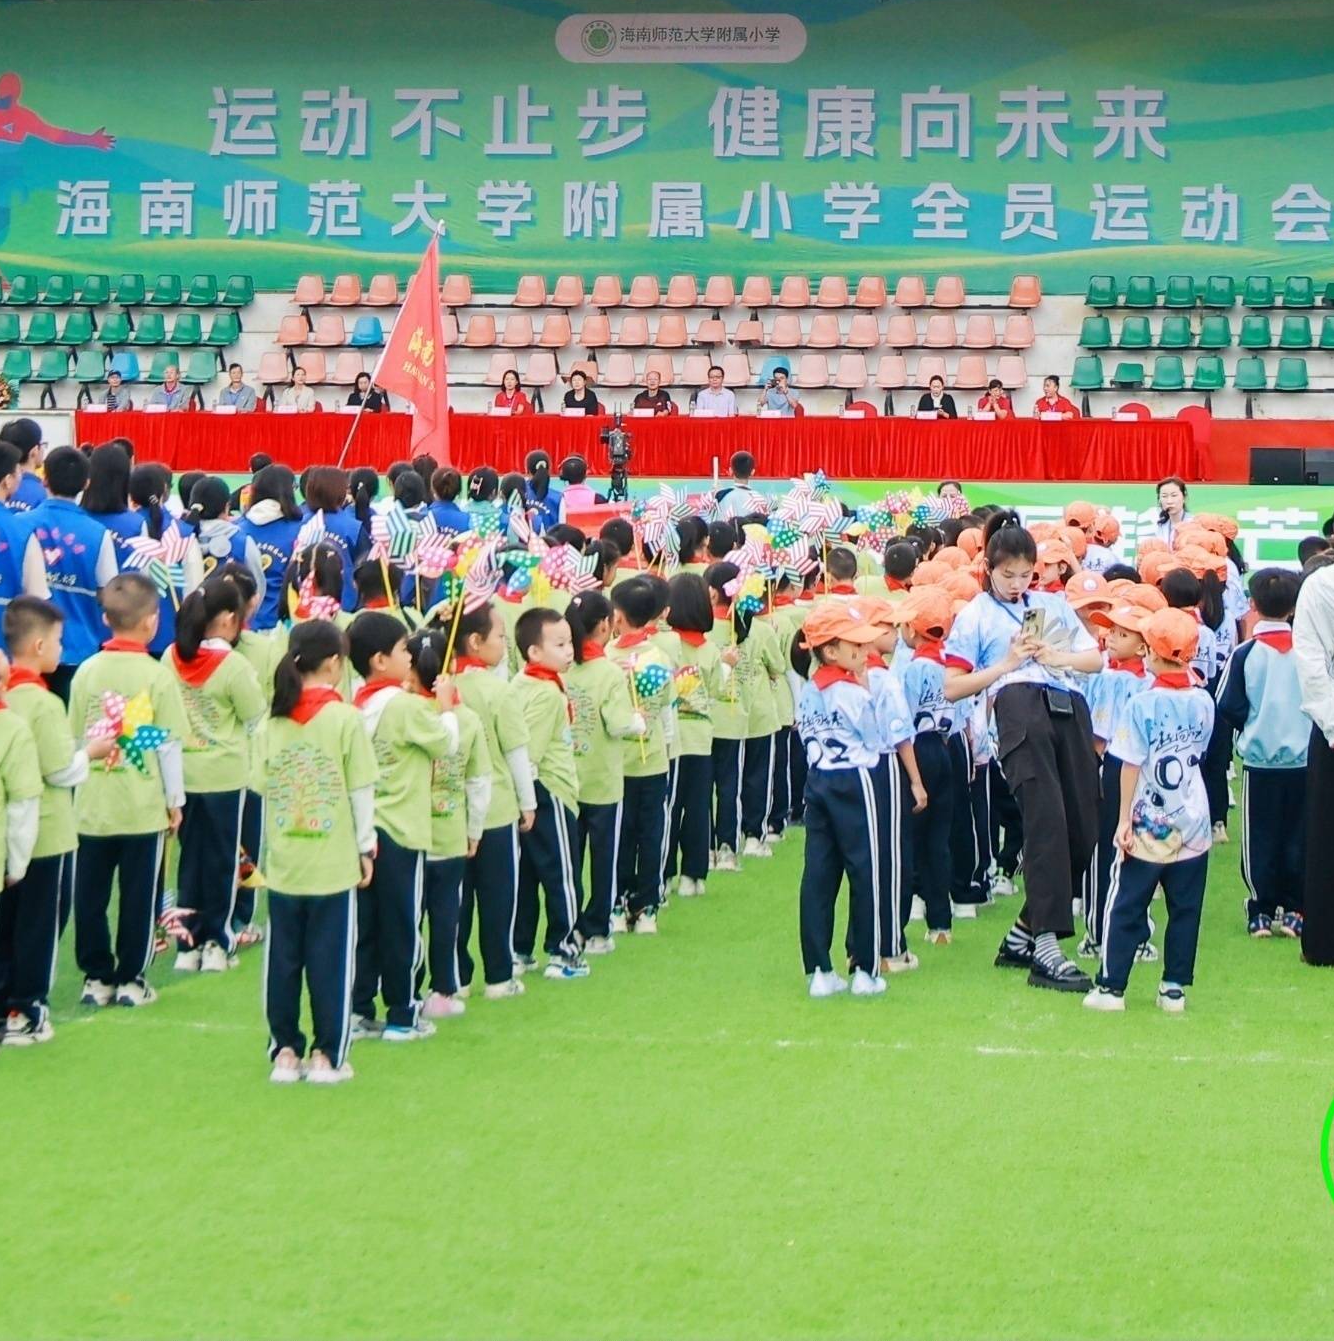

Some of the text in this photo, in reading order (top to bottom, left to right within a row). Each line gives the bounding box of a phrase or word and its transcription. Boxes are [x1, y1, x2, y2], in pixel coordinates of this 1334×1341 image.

[619, 26, 781, 44] 海南师范大学附属小学
[210, 85, 1169, 161] 运动不止步 健康向未来
[56, 179, 1334, 244] 海南师范大学附属小学全员运动会
